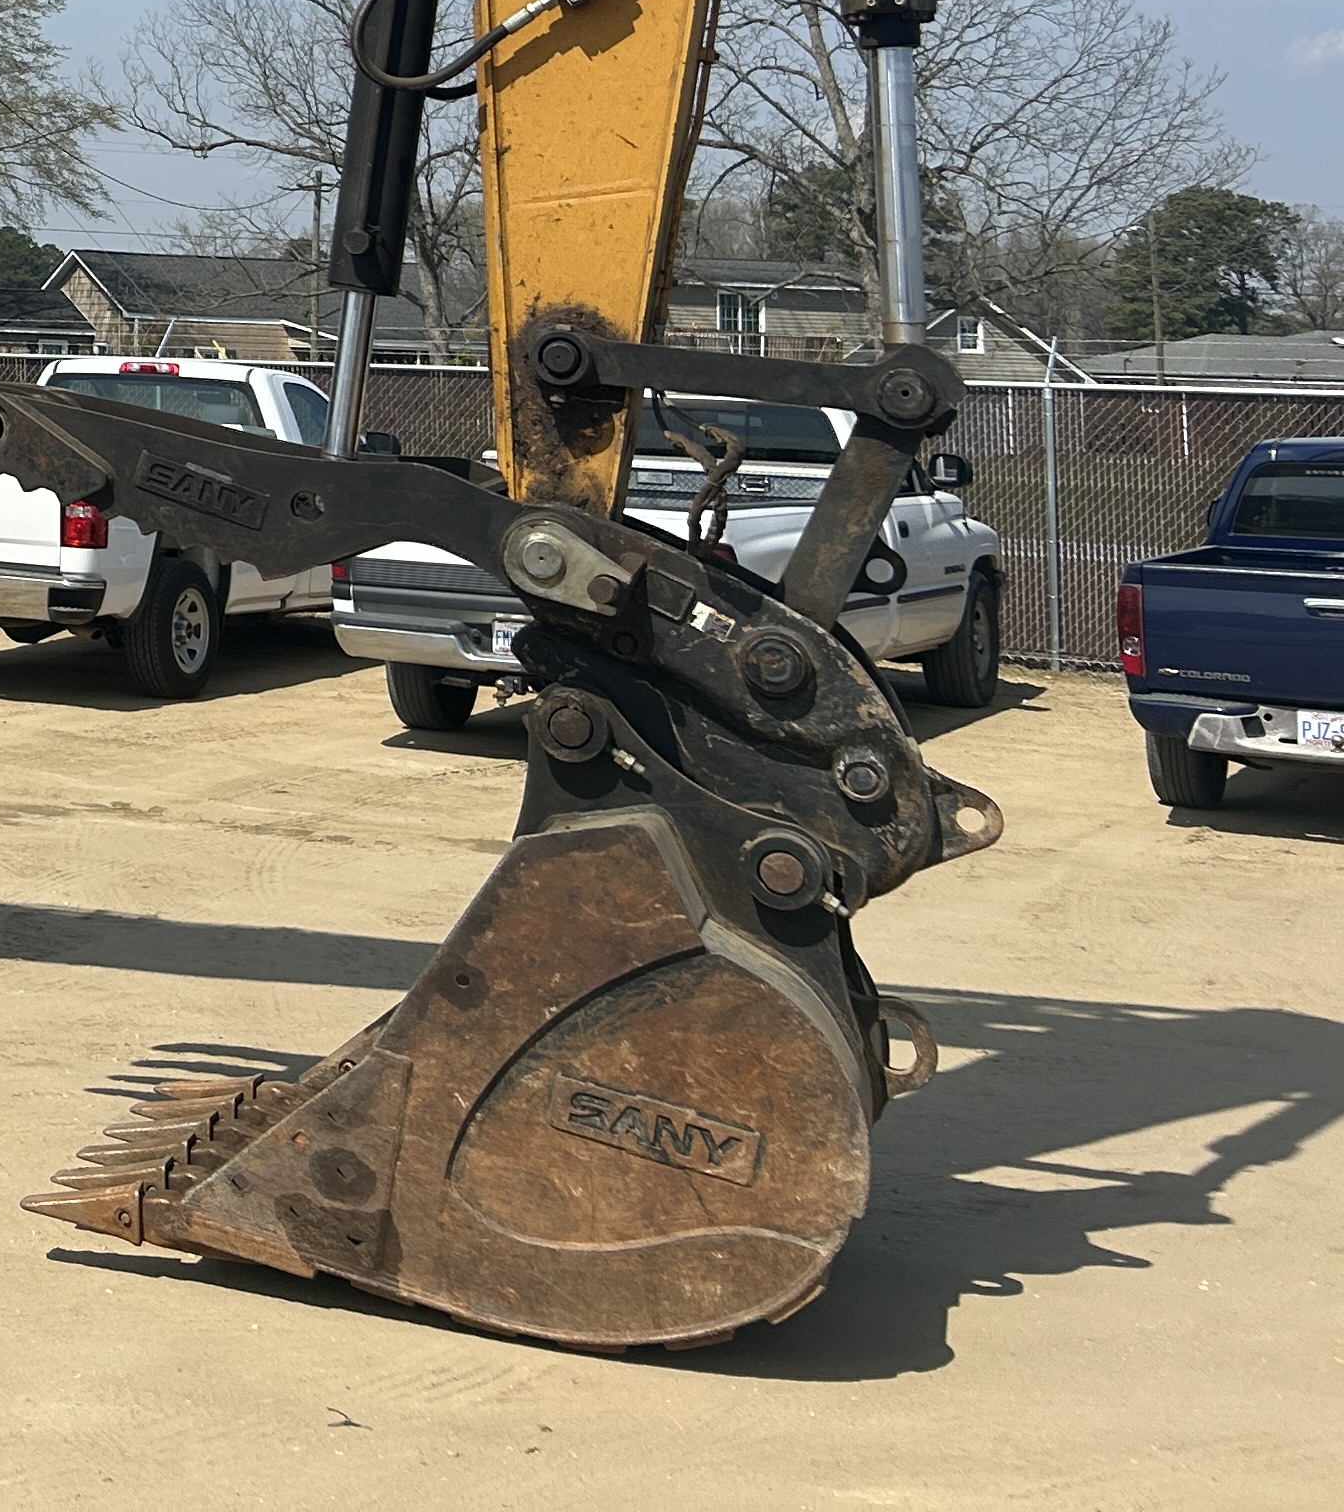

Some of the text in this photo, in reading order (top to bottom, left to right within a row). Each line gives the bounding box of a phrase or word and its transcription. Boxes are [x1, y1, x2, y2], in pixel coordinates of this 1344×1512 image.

[146, 462, 257, 519] SANY
[1179, 669, 1252, 683] COLORADO
[567, 1091, 745, 1168] SANY
